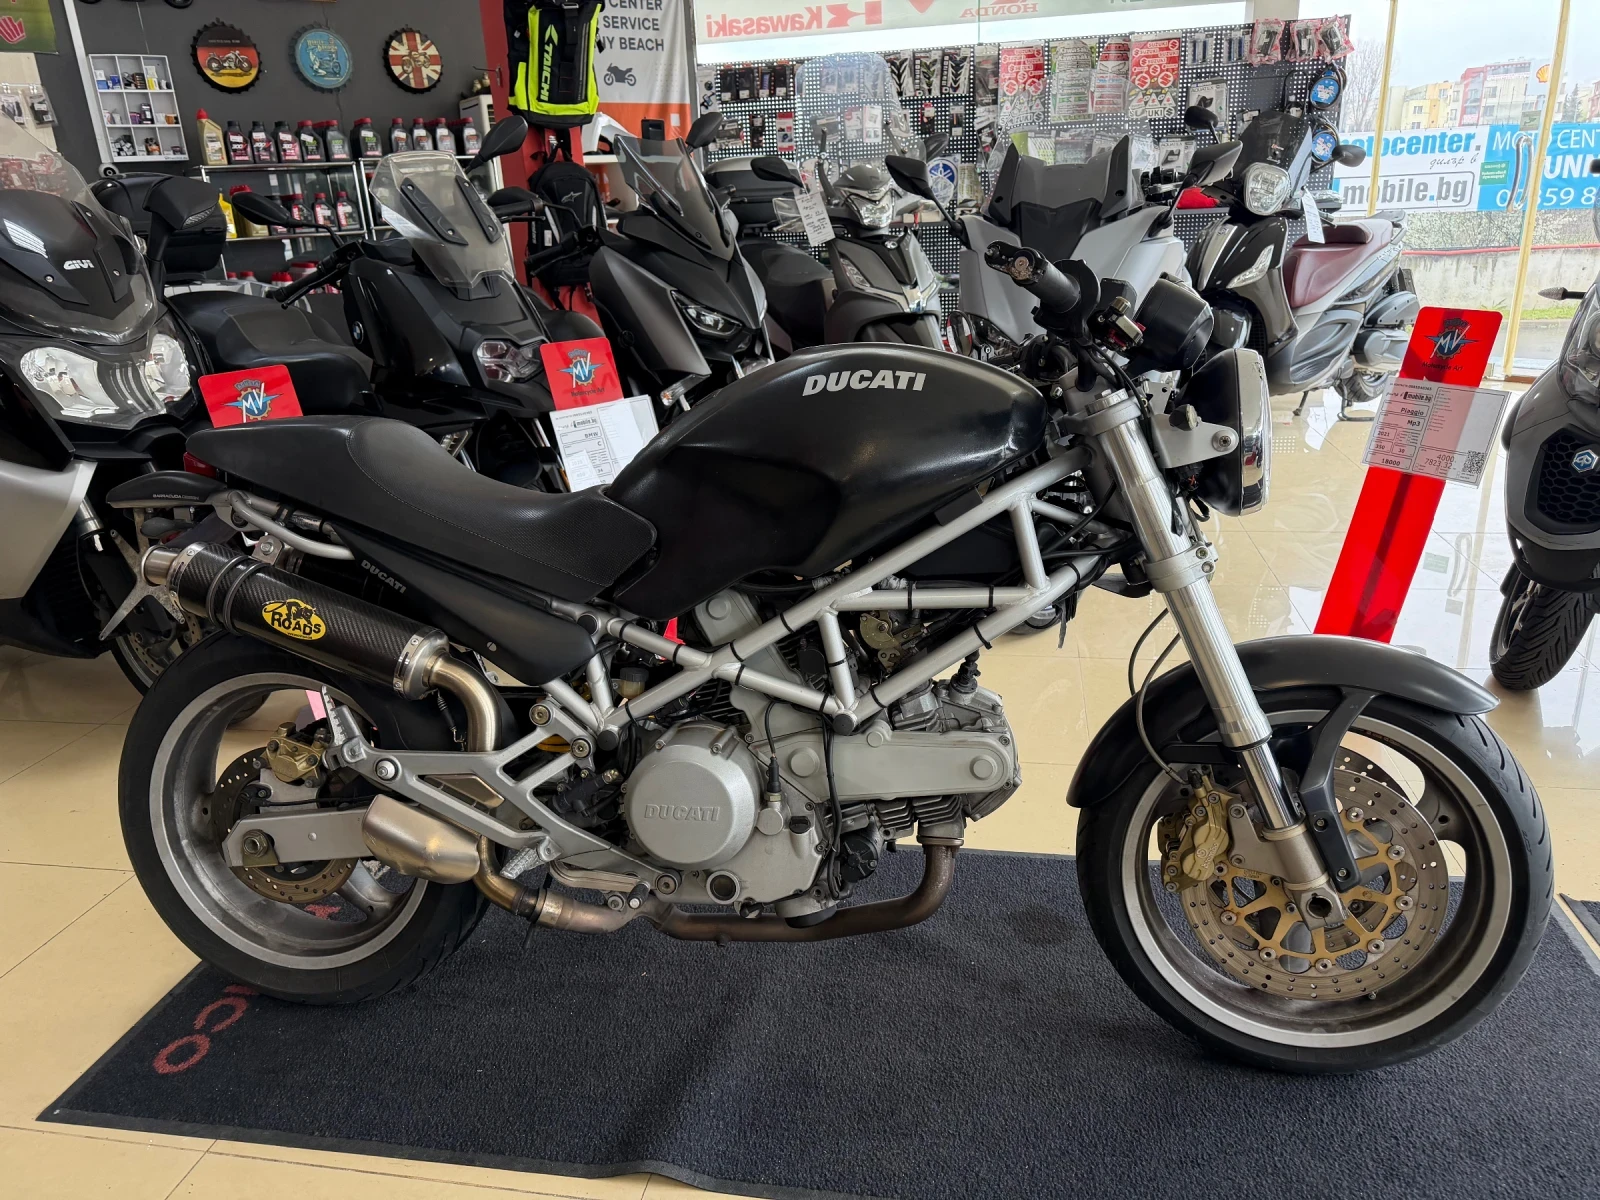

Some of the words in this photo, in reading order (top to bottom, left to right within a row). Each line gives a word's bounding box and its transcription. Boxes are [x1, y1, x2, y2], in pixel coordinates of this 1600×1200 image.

[610, 0, 663, 11] CENTER
[603, 15, 660, 31] SERVICE
[620, 37, 664, 51] BEACH
[540, 42, 554, 101] TAICHI
[63, 259, 95, 270] GIVI
[802, 369, 927, 397] DUCATI
[1400, 407, 1424, 416] Piaggio
[1407, 419, 1421, 427] Mp3
[584, 431, 599, 439] BMW
[1382, 458, 1401, 467] 18000
[1425, 458, 1452, 470] 7823.32
[361, 559, 407, 594] DUCATI
[270, 611, 322, 635] ROADS
[644, 803, 721, 821] DUCATI
[1201, 842, 1218, 869] brembo
